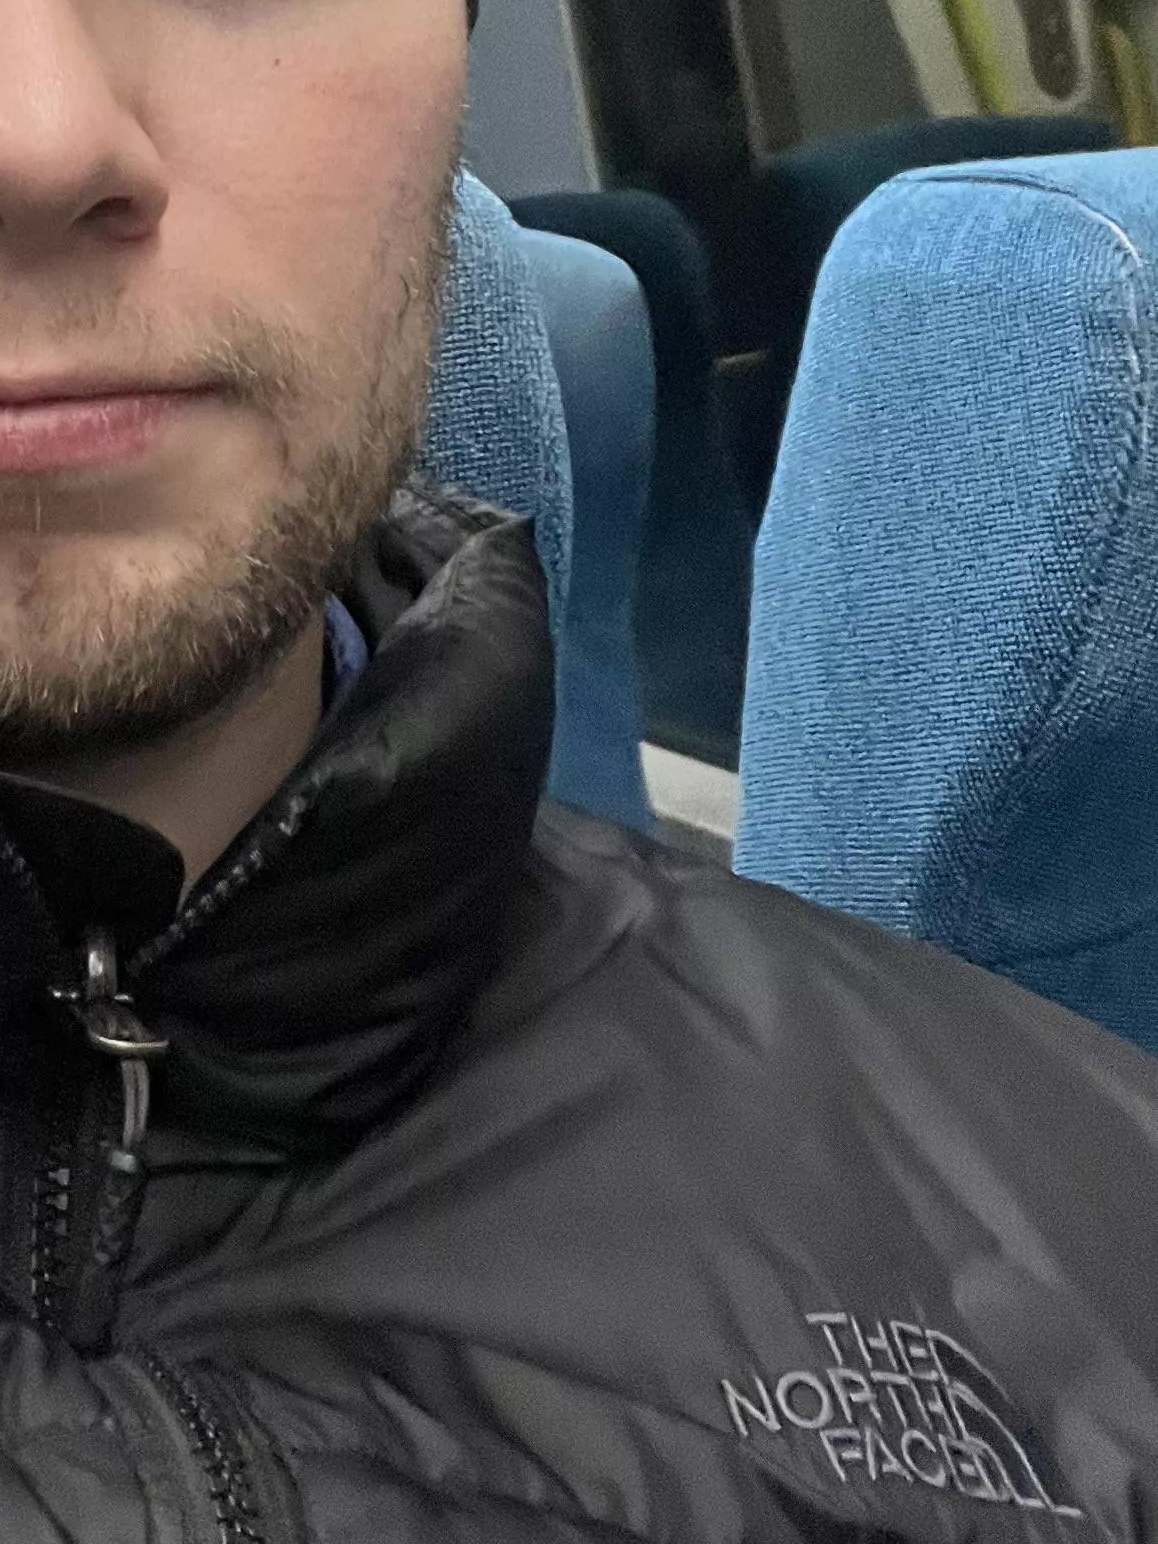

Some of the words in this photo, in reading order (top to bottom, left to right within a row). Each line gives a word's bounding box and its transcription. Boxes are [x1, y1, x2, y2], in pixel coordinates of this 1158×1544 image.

[805, 1311, 939, 1381] THE
[720, 1366, 957, 1438] NORTH
[819, 1423, 1010, 1502] FACE
